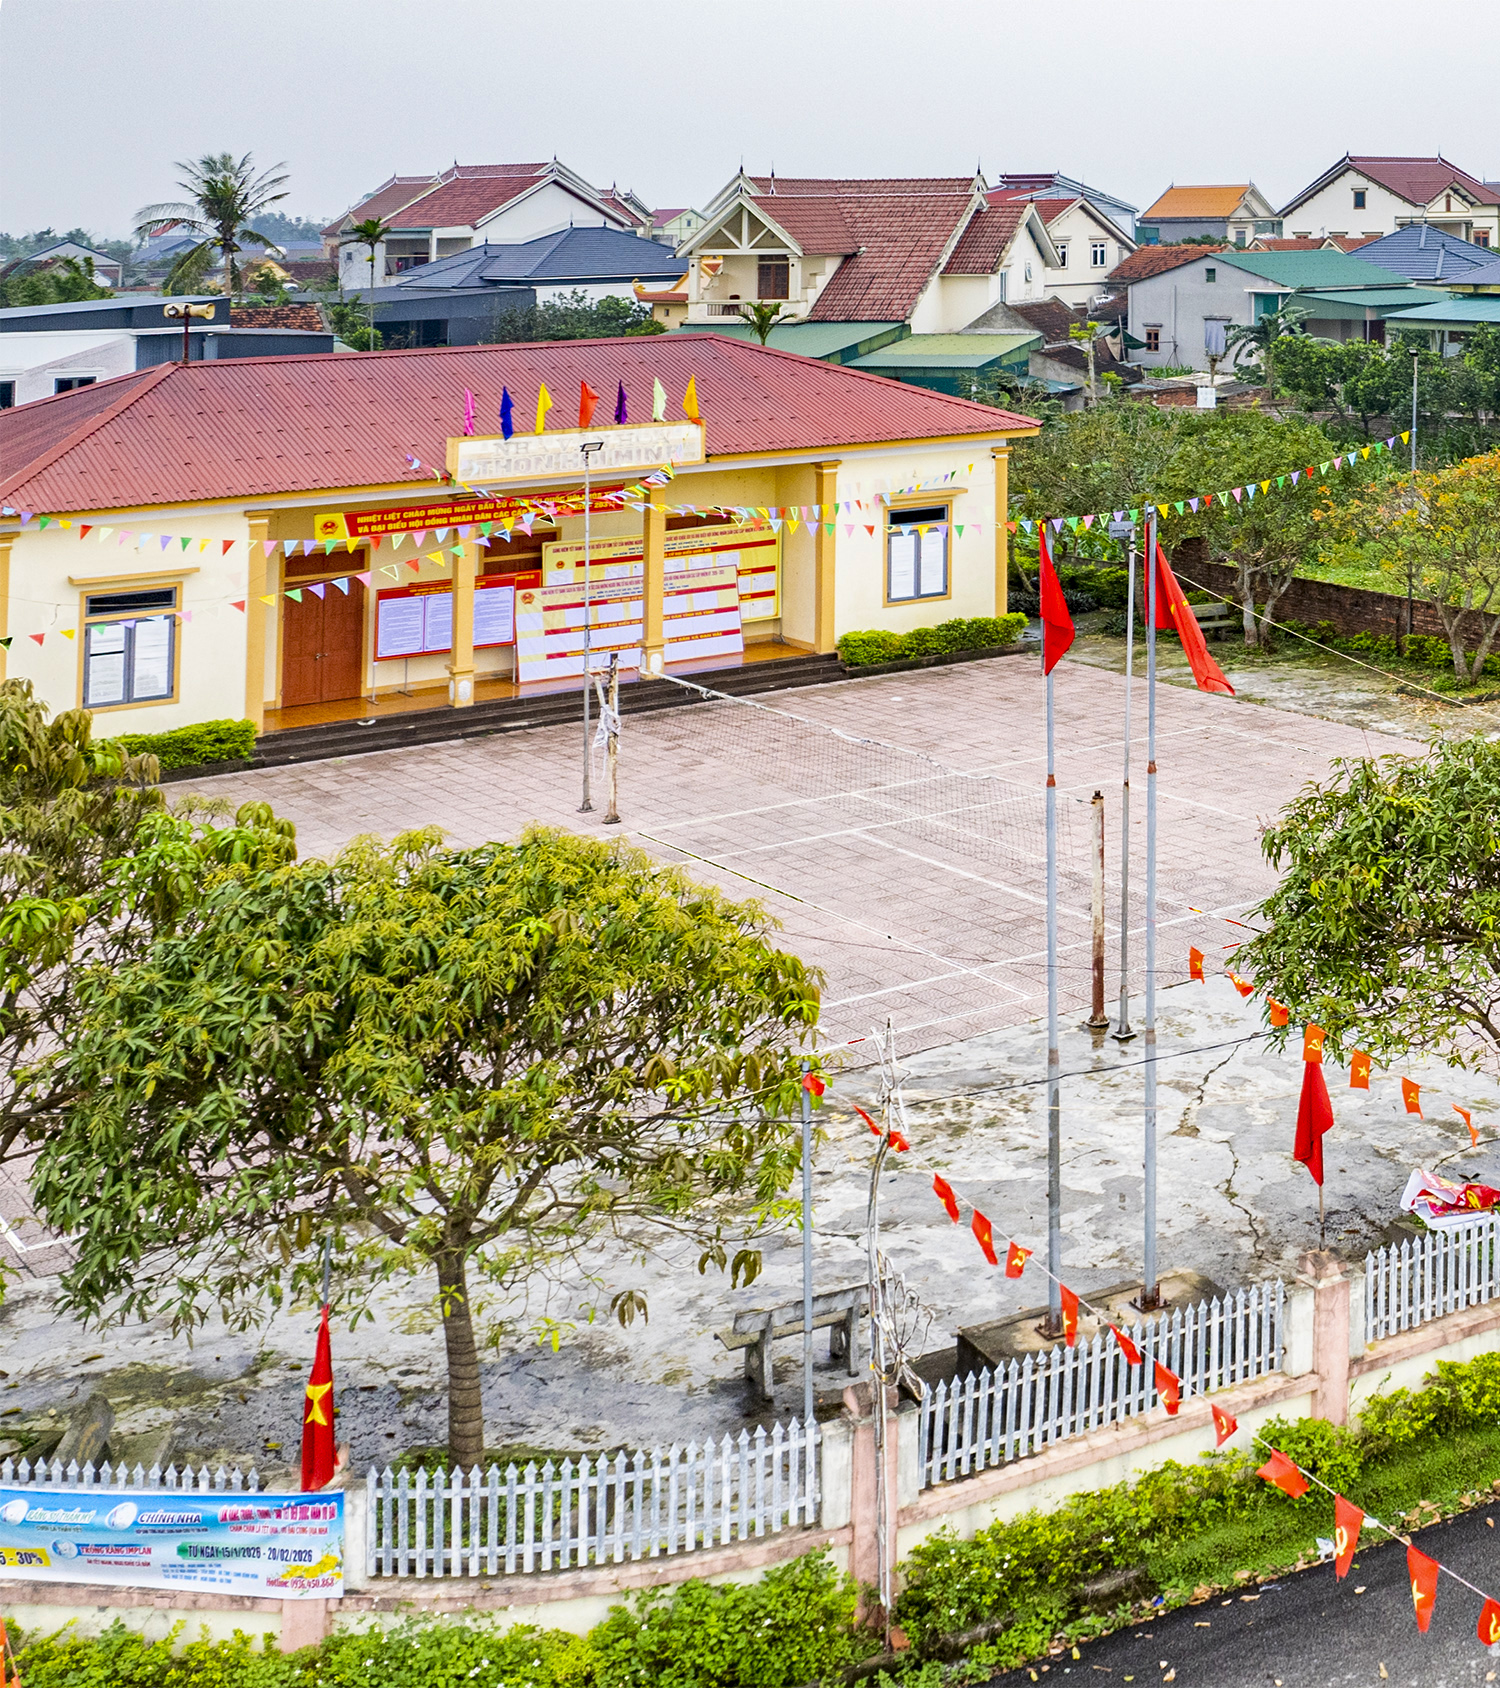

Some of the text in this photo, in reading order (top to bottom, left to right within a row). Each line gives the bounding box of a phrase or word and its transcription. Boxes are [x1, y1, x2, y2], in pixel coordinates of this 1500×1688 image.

[357, 514, 382, 523] NHIỆT
[384, 512, 401, 522] LIỆT
[402, 510, 426, 519] CHÀO
[454, 503, 475, 513] NGÀY
[357, 525, 369, 533] VÀ
[408, 519, 423, 529] HỘI
[449, 514, 473, 524] NHÂN
[474, 512, 492, 521] DÂN
[493, 510, 510, 519] CÁC
[177, 1513, 201, 1523] NHA
[15, 1551, 43, 1565] 30%
[125, 1547, 152, 1555] IMPLAN
[267, 1547, 313, 1562] 20/02/2026
